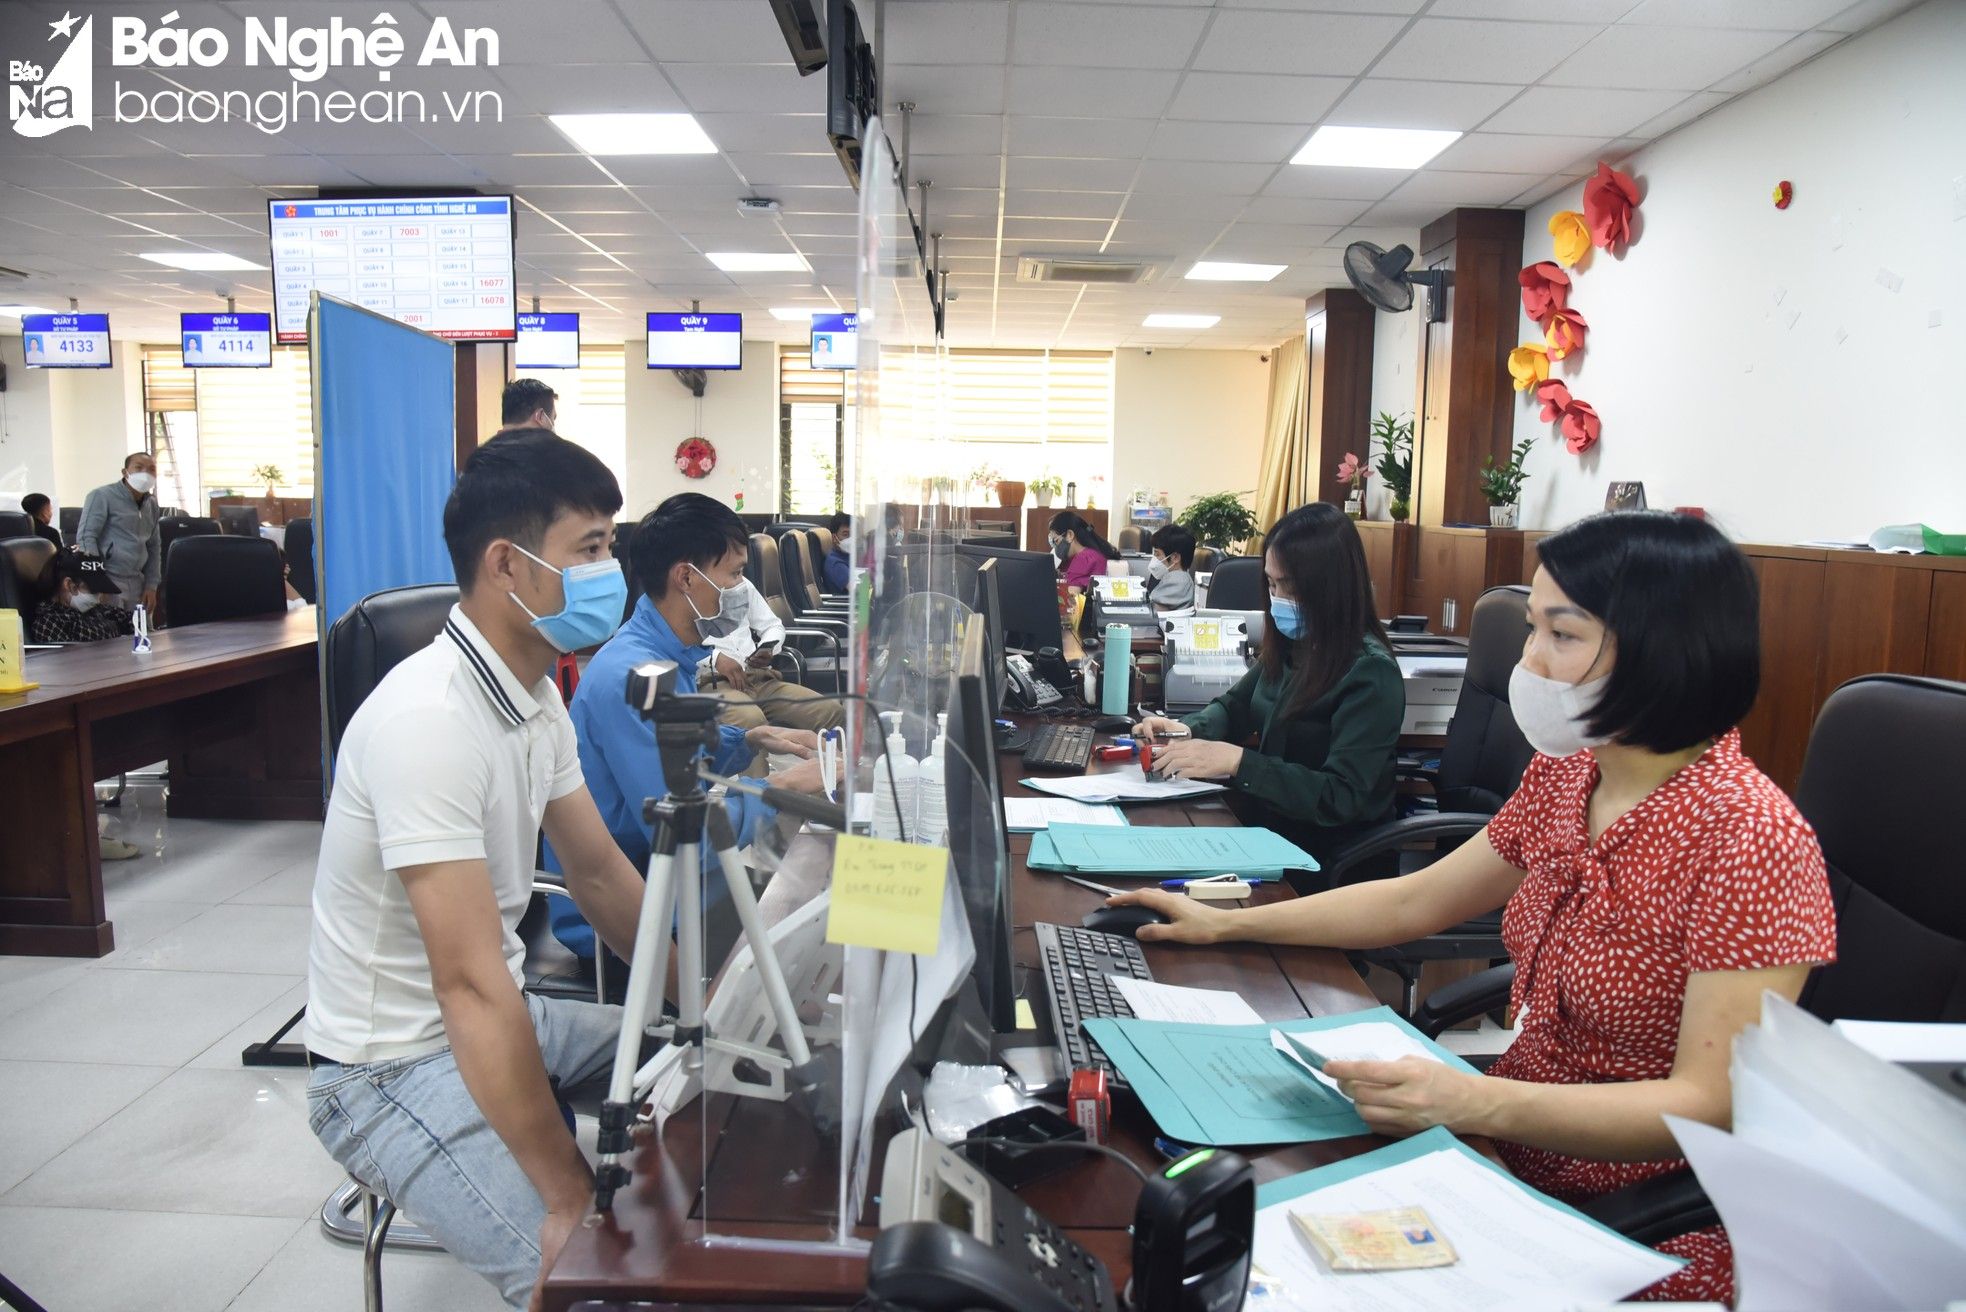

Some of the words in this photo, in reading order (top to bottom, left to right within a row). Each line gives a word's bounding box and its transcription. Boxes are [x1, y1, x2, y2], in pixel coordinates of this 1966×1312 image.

[320, 229, 338, 237] 1001
[400, 228, 420, 236] 7003
[480, 279, 504, 287] 16077
[480, 296, 505, 304] 16078
[540, 316, 546, 324] 8
[702, 317, 708, 325] 9
[60, 340, 94, 352] 4133
[219, 340, 254, 352] 4114
